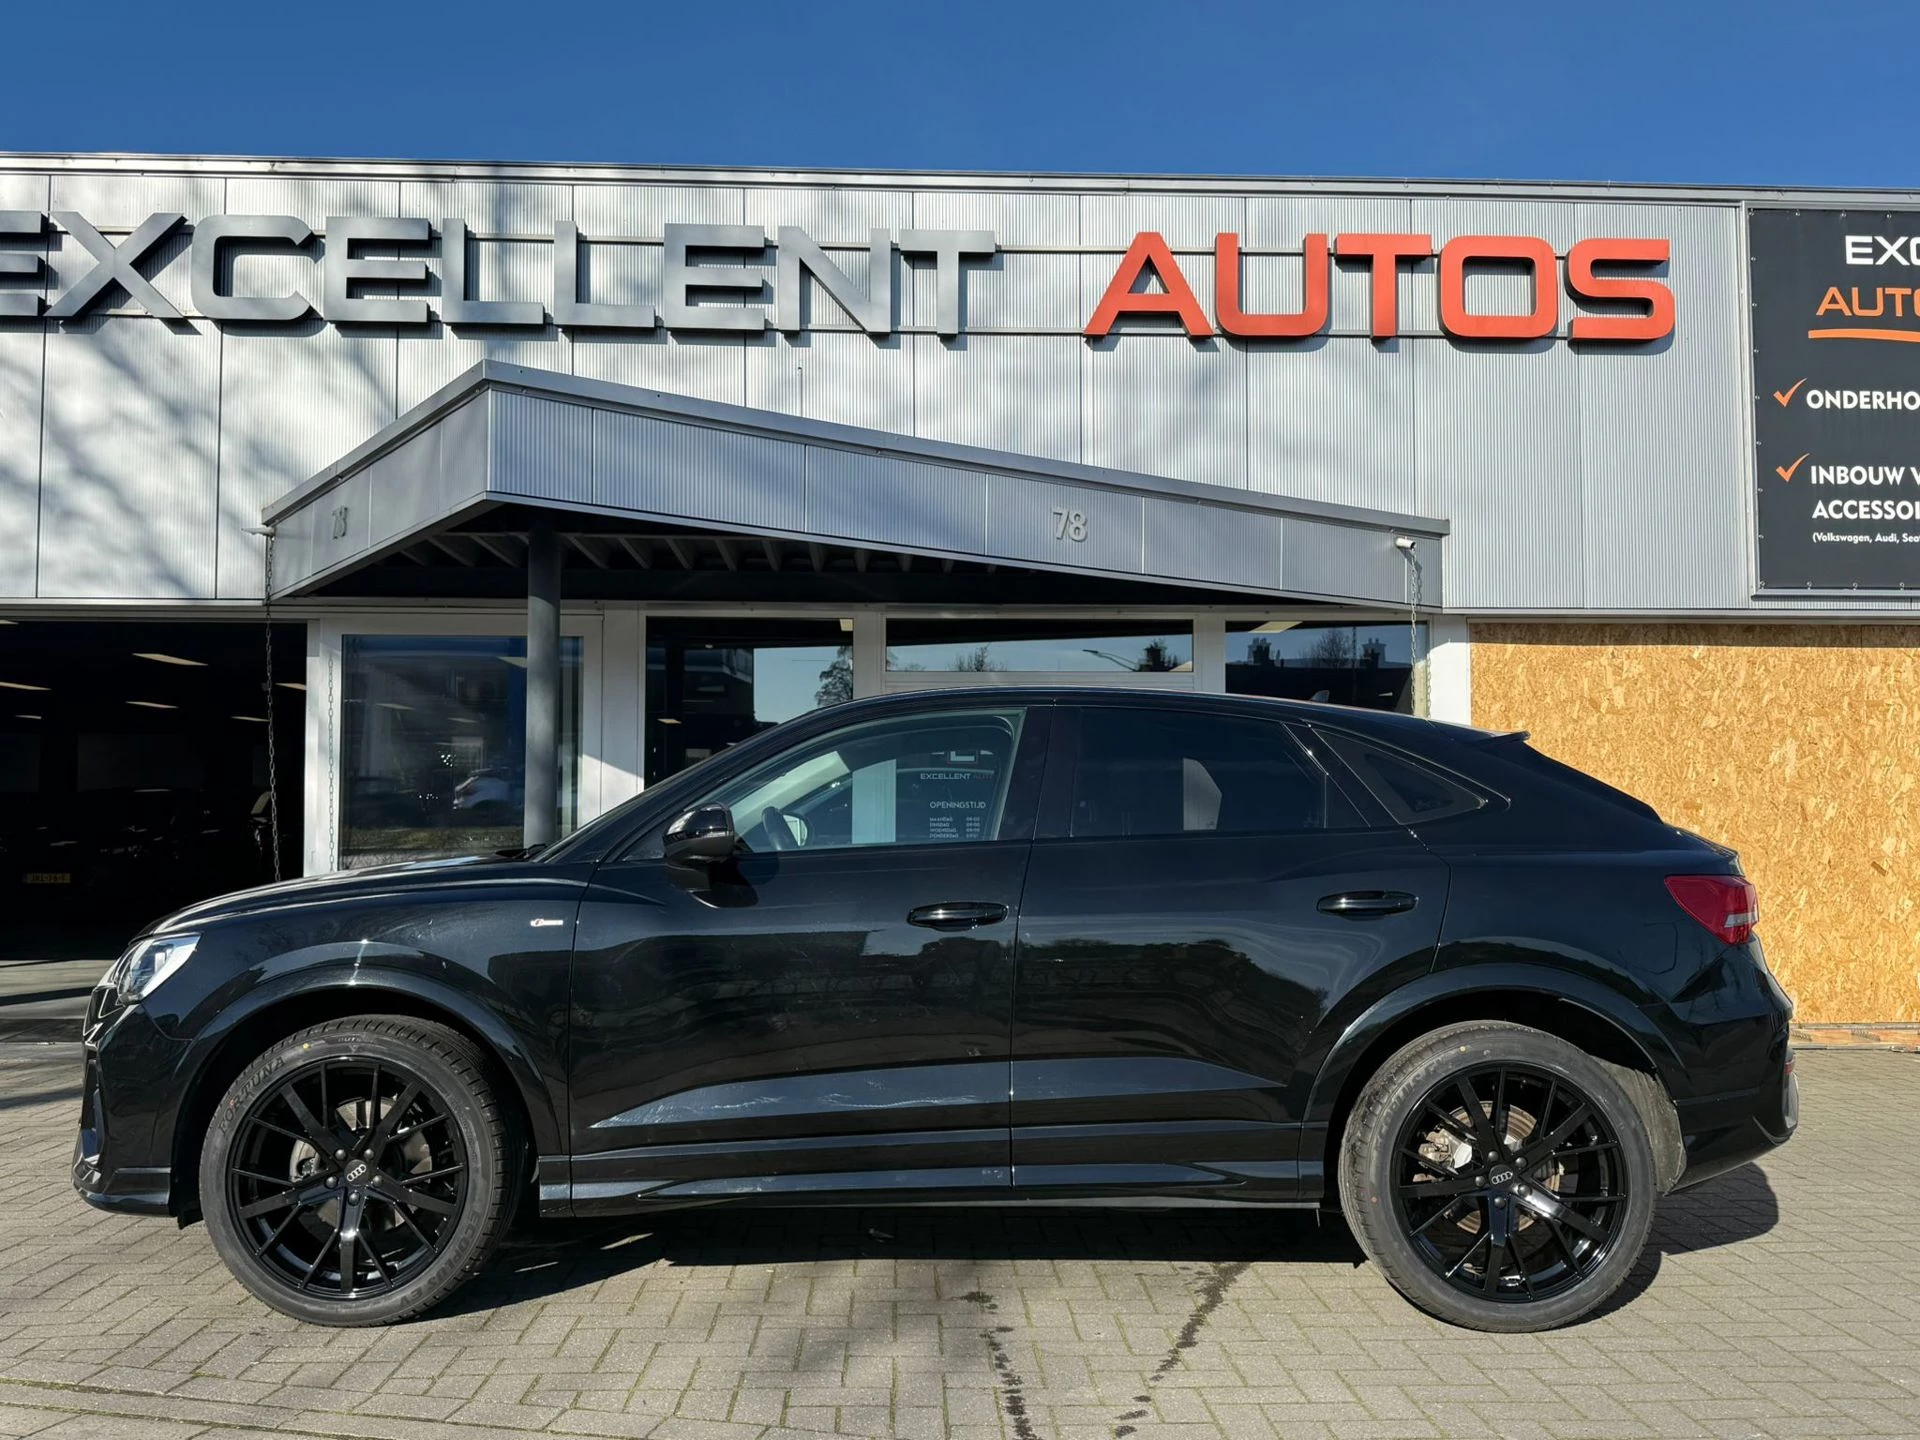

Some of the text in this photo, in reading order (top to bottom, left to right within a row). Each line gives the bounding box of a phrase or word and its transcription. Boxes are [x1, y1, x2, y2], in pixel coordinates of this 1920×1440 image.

[1084, 231, 1676, 341] AUTOS
[1815, 286, 1920, 317] AUT
[1806, 389, 1920, 411] ONDERHO
[1810, 465, 1906, 487] INBOUW
[1052, 506, 1088, 543] 78
[1812, 532, 1920, 545] (Volkswagen, Audi, Sea
[217, 1056, 286, 1135] FORTUNA
